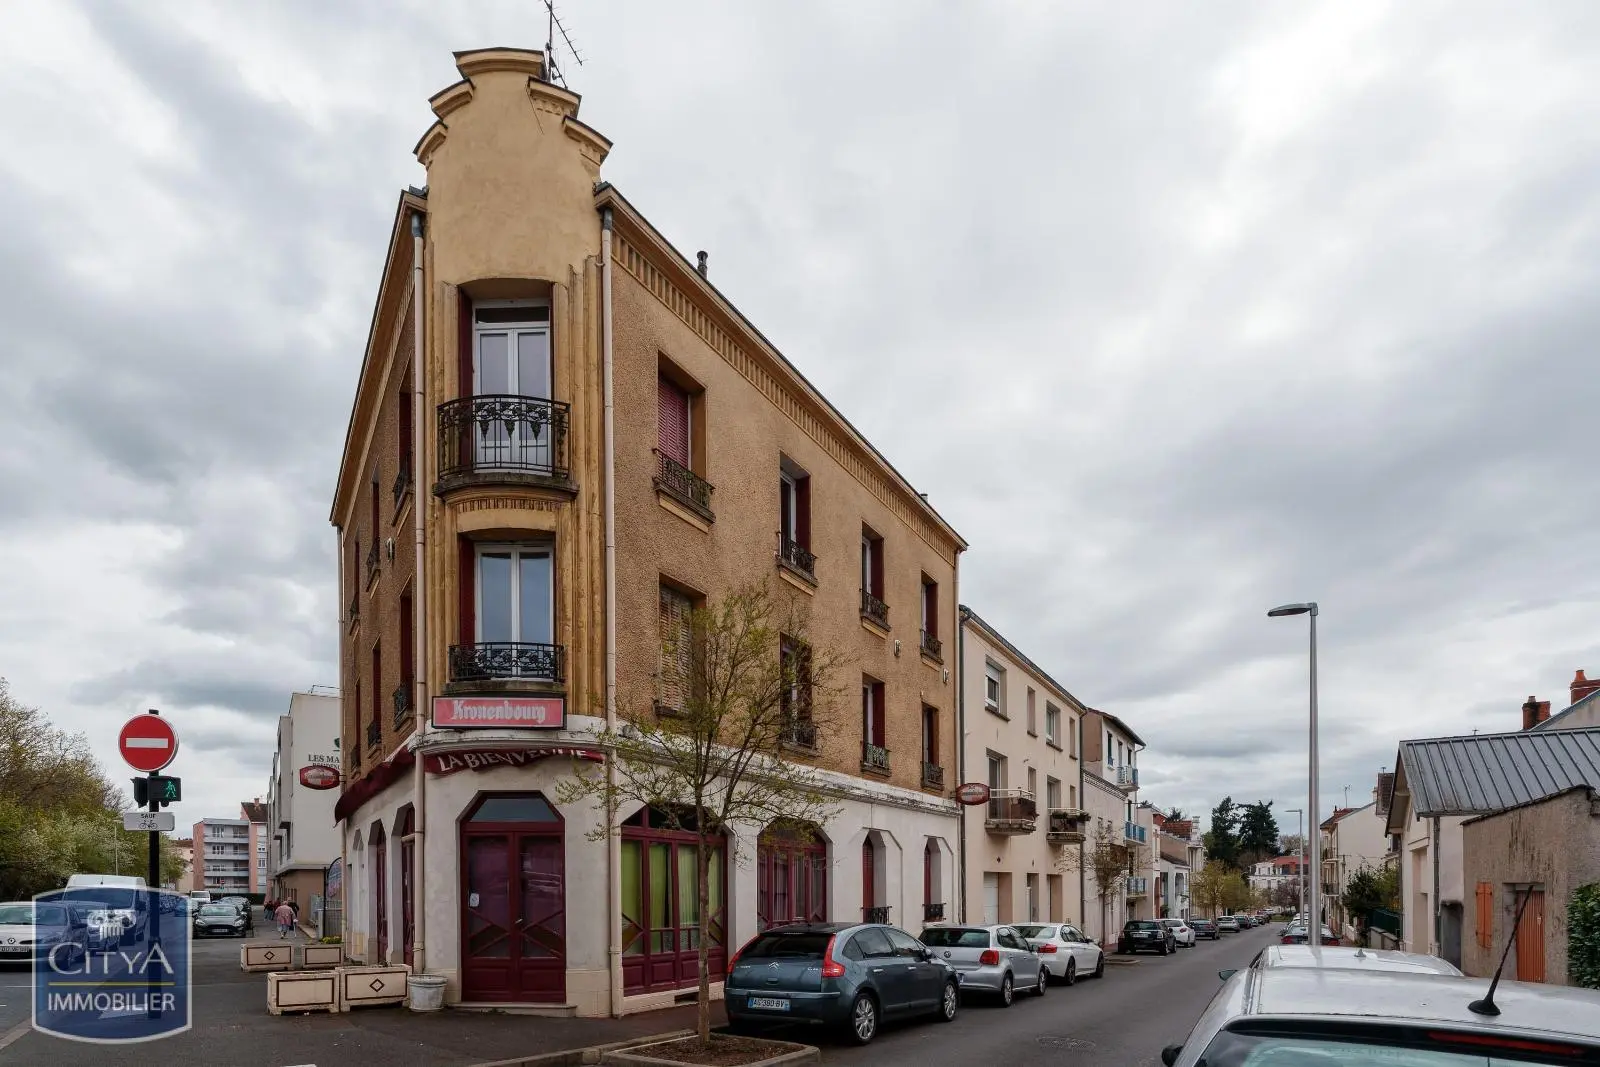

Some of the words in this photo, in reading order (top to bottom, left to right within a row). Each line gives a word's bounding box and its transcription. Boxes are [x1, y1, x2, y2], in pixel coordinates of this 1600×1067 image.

[451, 699, 546, 724] Kronenbourg
[308, 754, 325, 762] LES
[437, 754, 464, 772] LA
